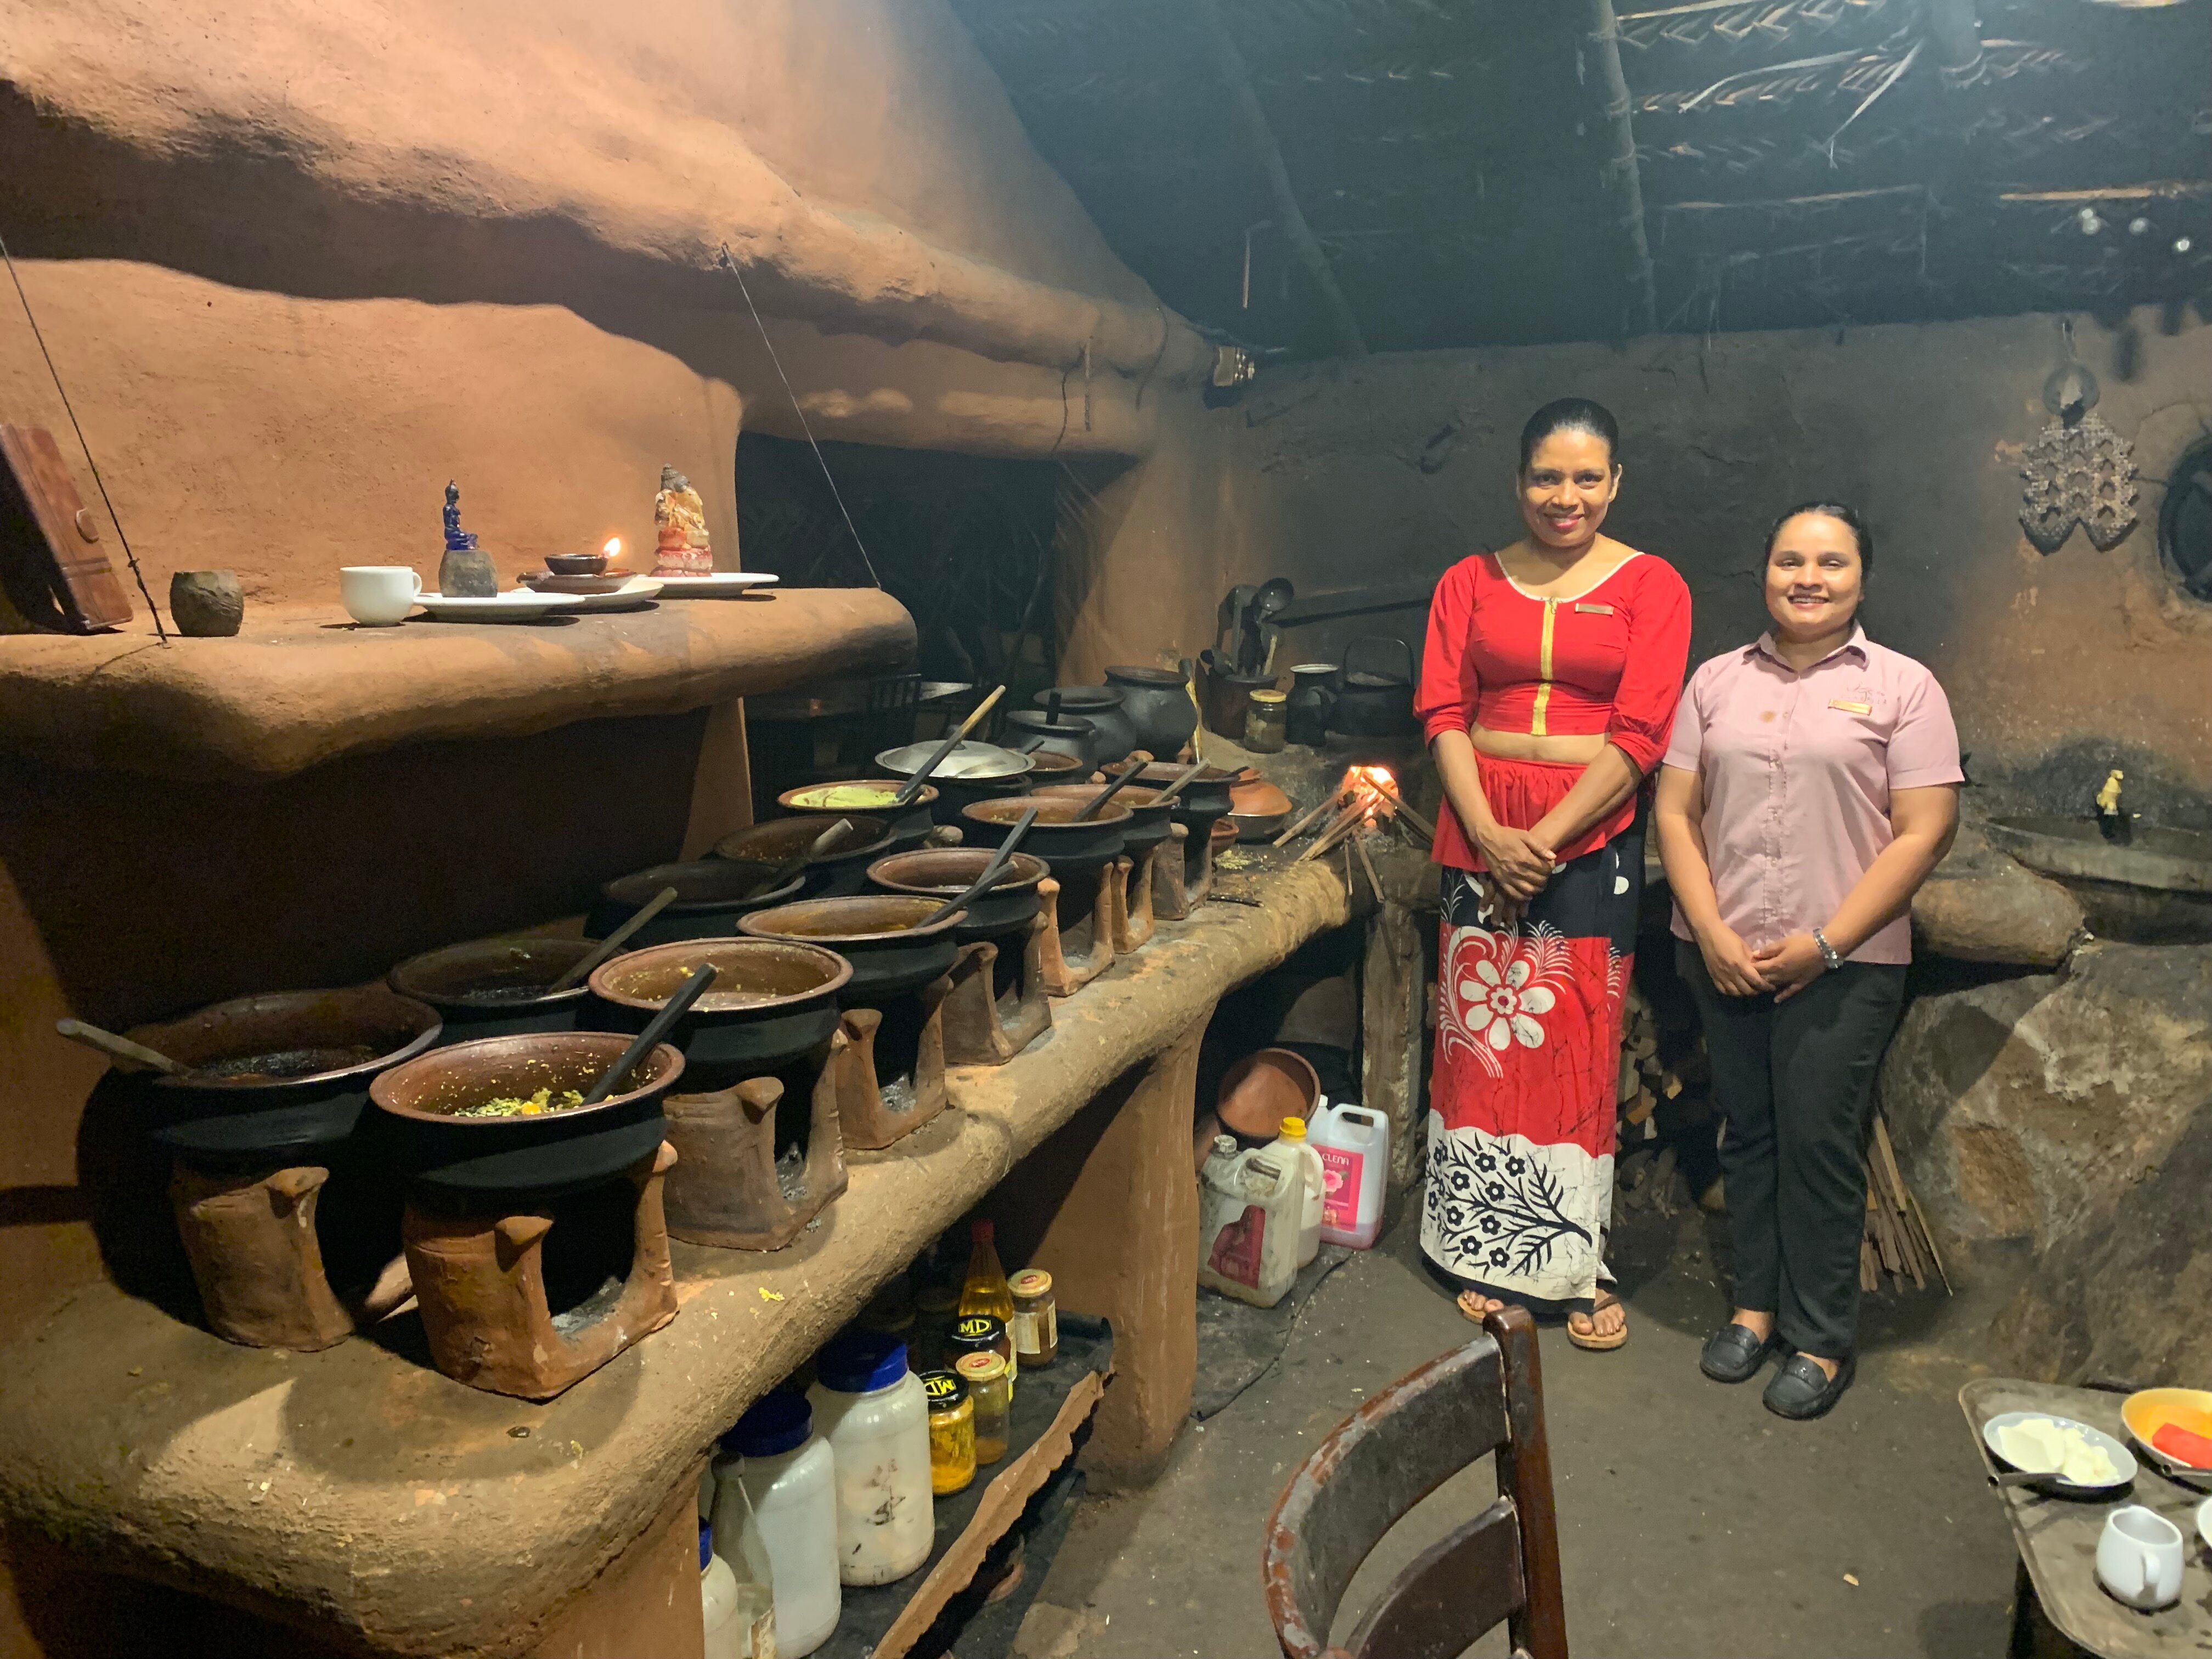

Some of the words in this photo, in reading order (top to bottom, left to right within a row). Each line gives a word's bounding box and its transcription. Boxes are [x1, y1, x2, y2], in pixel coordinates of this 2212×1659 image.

[1322, 1153, 1349, 1166] CLENA
[960, 1318, 990, 1334] MD
[924, 1379, 955, 1396] MD
